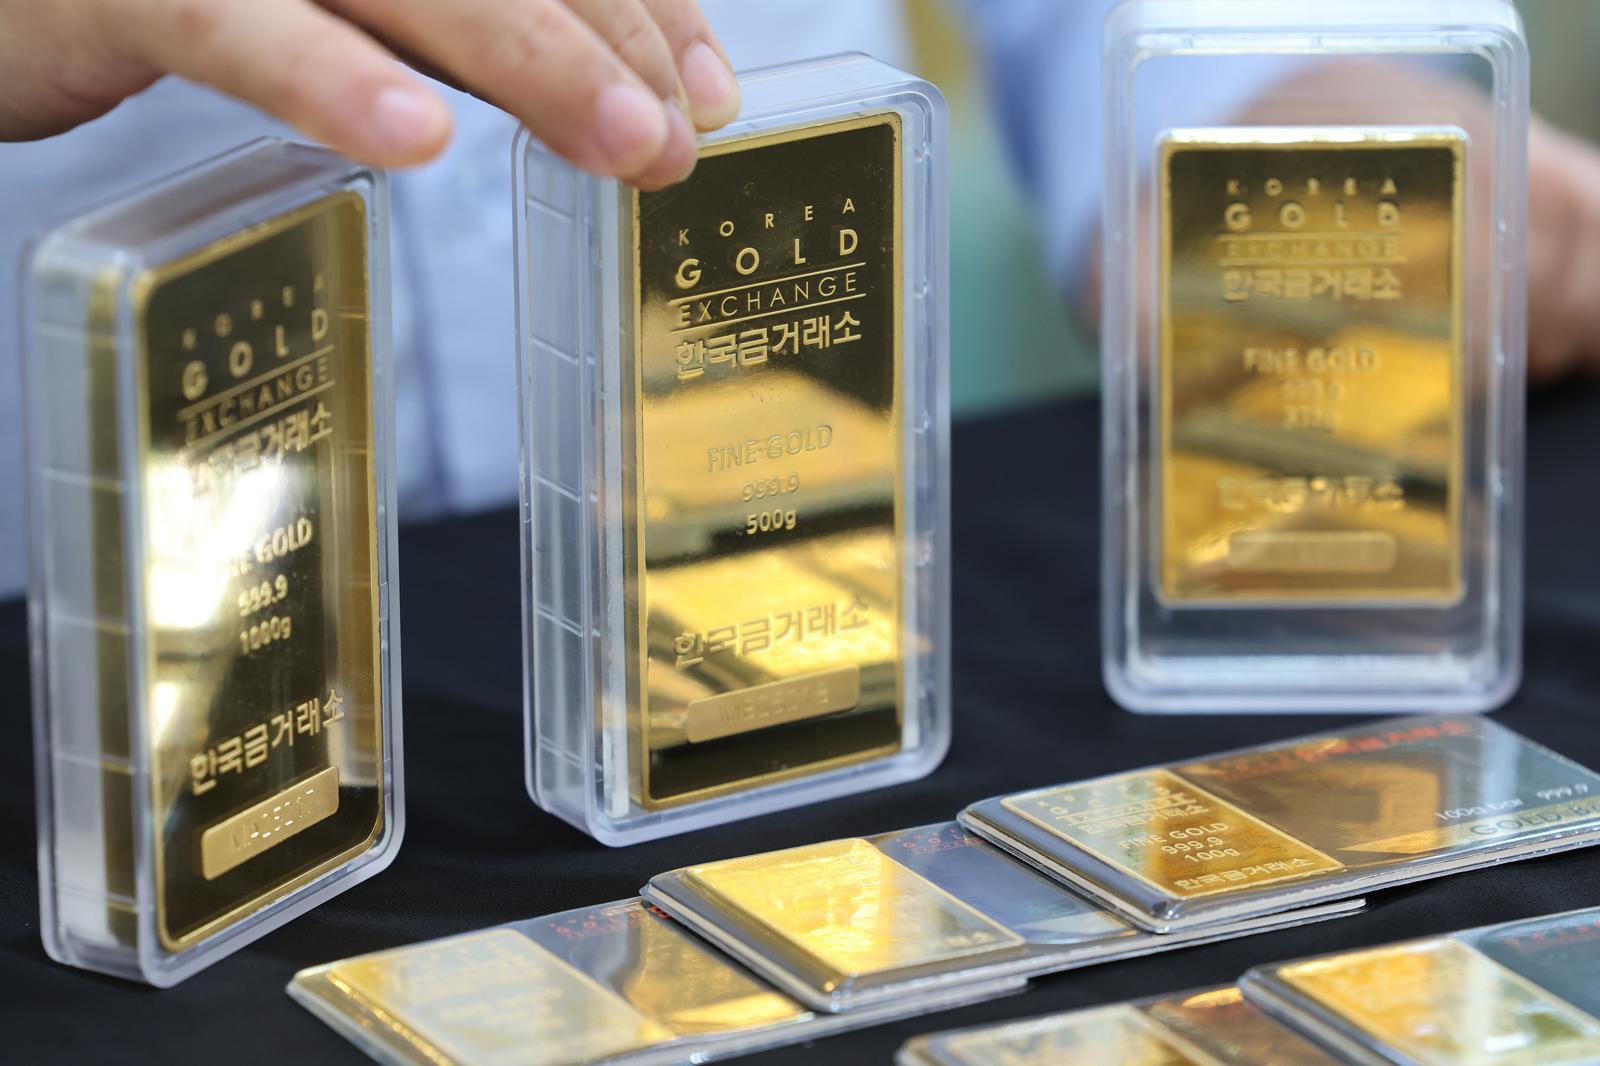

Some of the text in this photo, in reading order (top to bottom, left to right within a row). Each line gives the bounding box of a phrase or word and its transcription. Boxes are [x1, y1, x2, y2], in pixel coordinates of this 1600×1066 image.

[678, 198, 856, 247] KOREA
[1225, 201, 1400, 232] GOLD
[675, 228, 859, 290] GOLD
[679, 271, 858, 328] EXCHANGE
[182, 307, 329, 402] GOLD
[674, 310, 862, 382] 한국금거래소
[706, 424, 834, 473] FINE GOLD
[742, 471, 800, 503] 999.9
[256, 516, 313, 564] GOLD
[745, 507, 797, 536] 500g
[237, 573, 289, 617] 999.9
[674, 595, 871, 671] 한국금거래소
[189, 687, 346, 797] 한국금거래소
[1119, 821, 1230, 850] FINE GOLD
[1161, 836, 1224, 856] 999.9
[1470, 810, 1563, 836] GOLD
[1173, 856, 1316, 891] 한국금거래소
[1184, 847, 1241, 864] 100g
